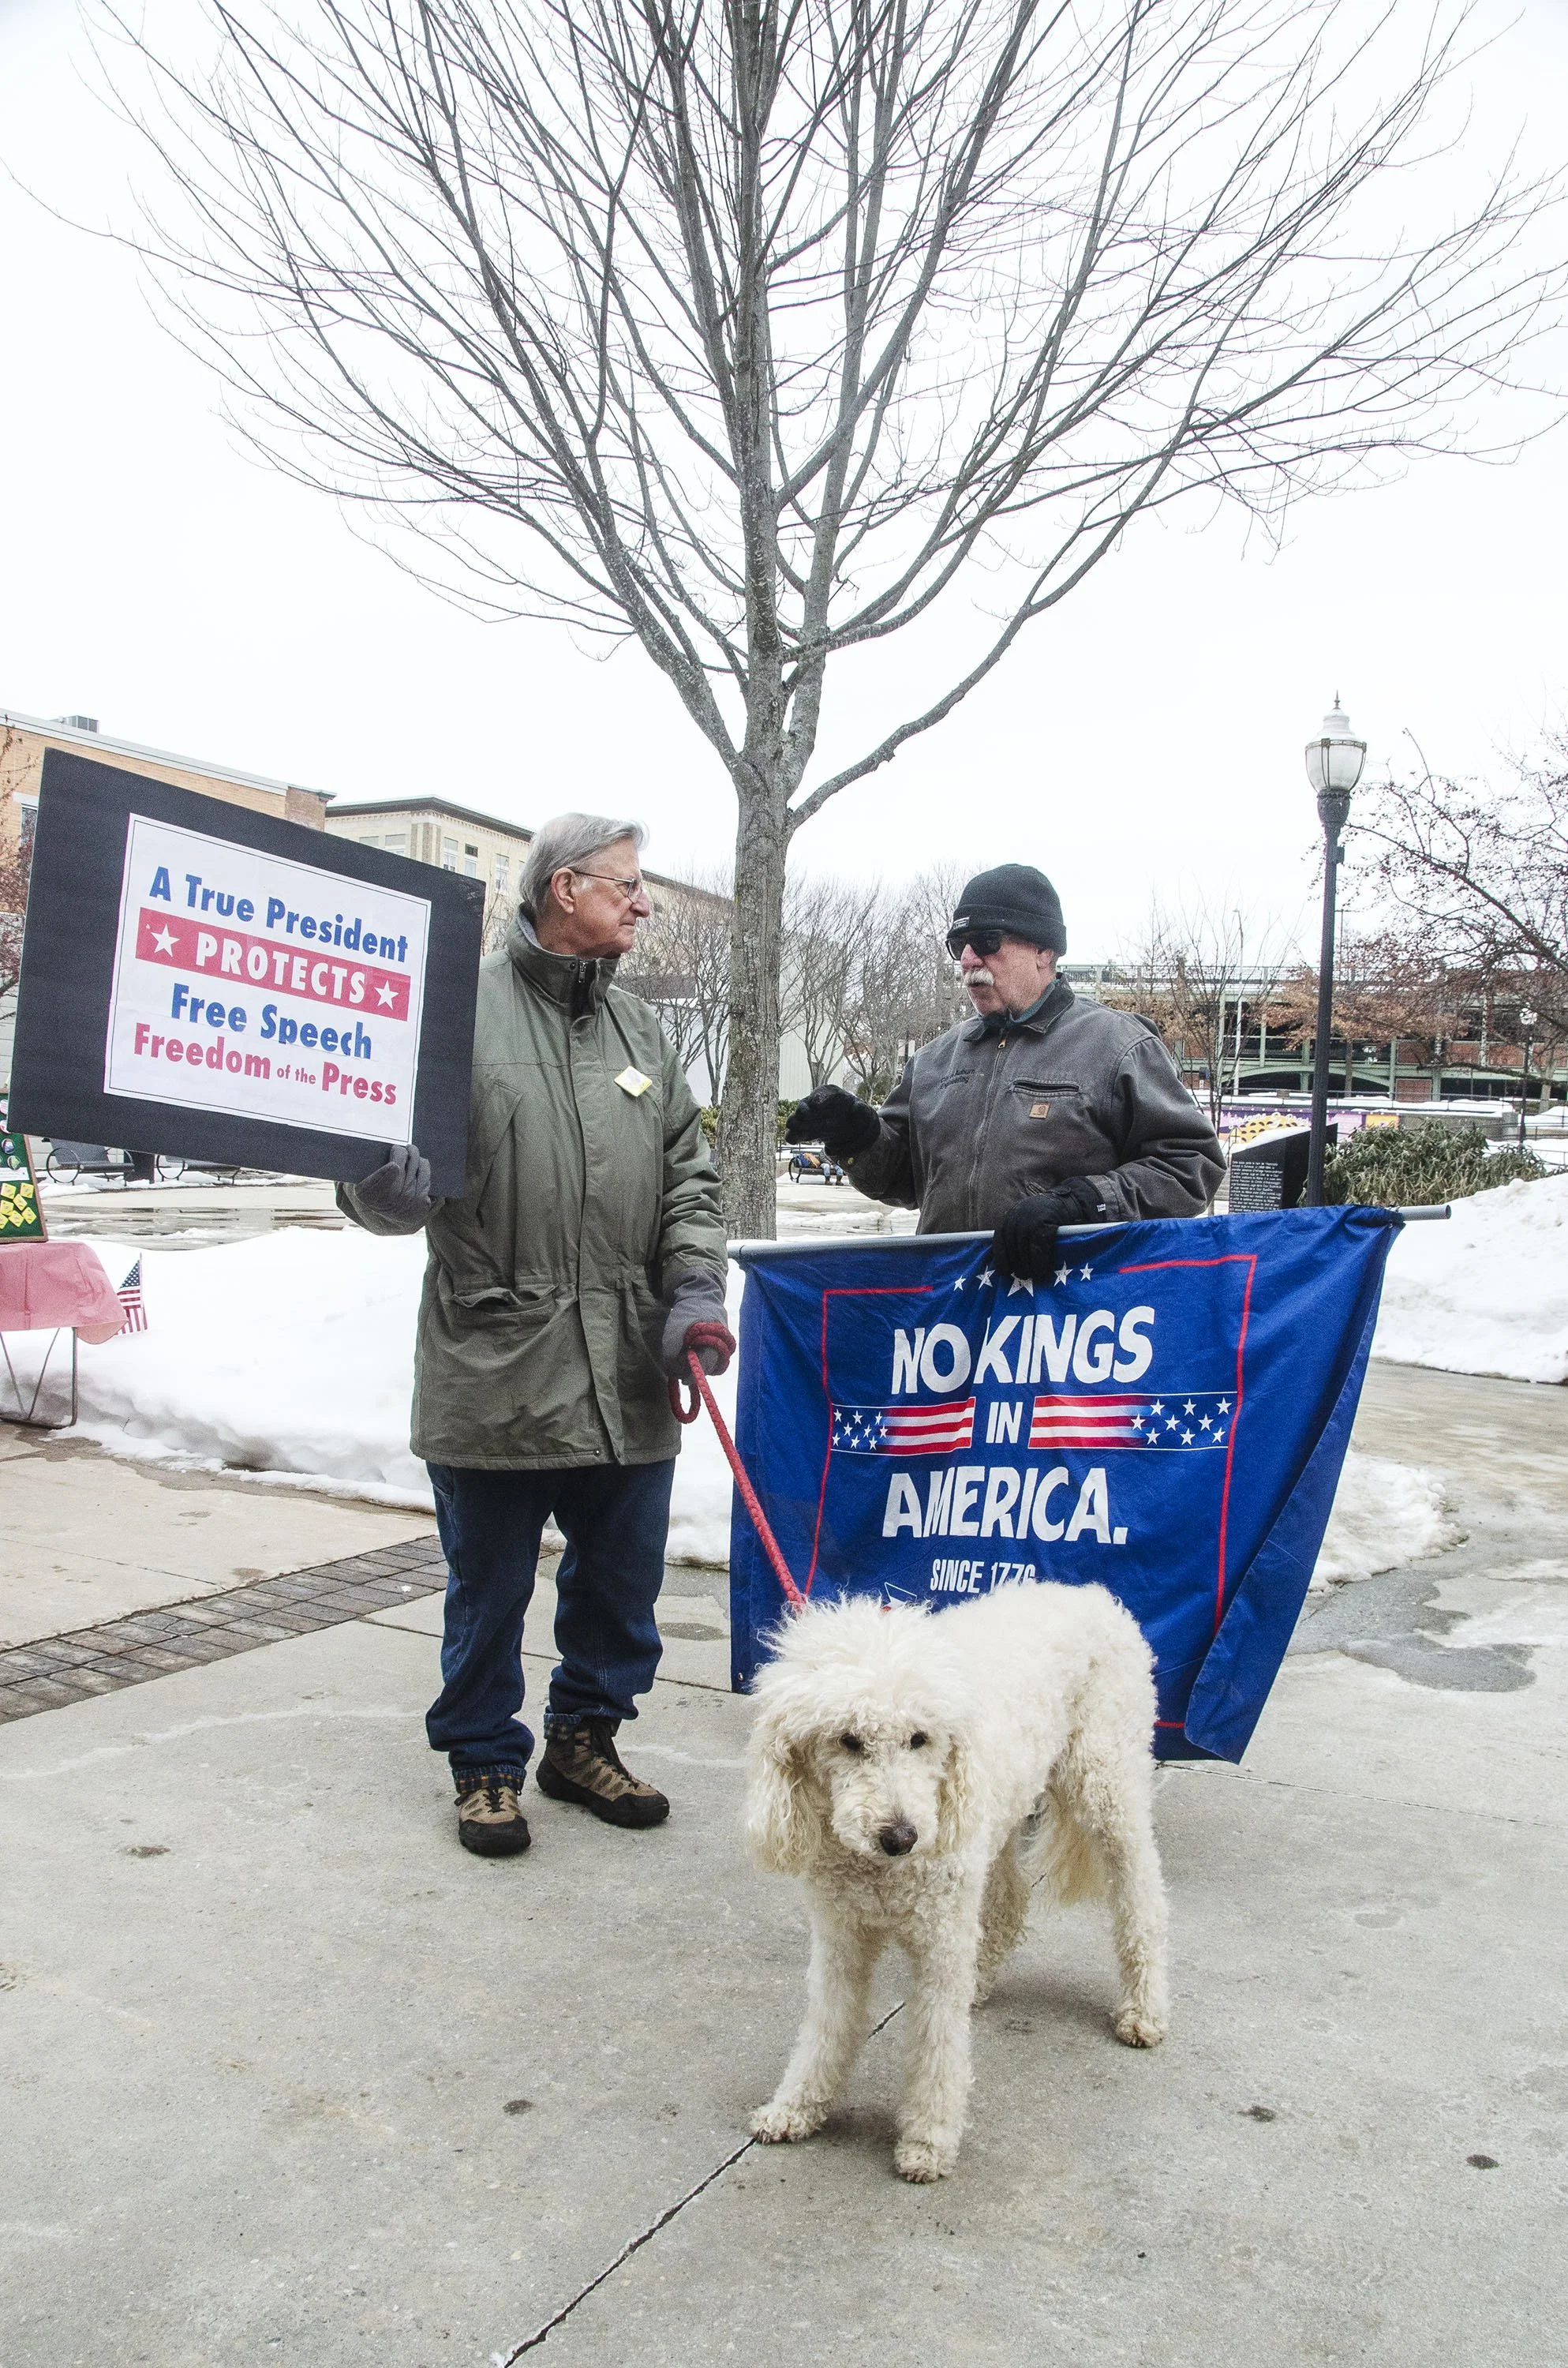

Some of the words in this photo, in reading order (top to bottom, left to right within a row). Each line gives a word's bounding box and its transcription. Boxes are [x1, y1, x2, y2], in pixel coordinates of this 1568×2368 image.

[149, 866, 171, 902] A
[185, 874, 255, 922] True
[266, 897, 408, 963] President
[196, 932, 365, 1003] PROTECTS
[171, 983, 247, 1032] Free
[260, 1004, 372, 1060] Speech
[134, 1023, 271, 1080] Freedom
[277, 1065, 291, 1080] of
[295, 1068, 316, 1085] the
[322, 1062, 397, 1106] Press
[891, 1323, 971, 1395] NO
[973, 1306, 1155, 1384] KINGS
[986, 1401, 1024, 1444] IN
[882, 1466, 1128, 1545] AMERICA.
[930, 1559, 985, 1594] SINCE
